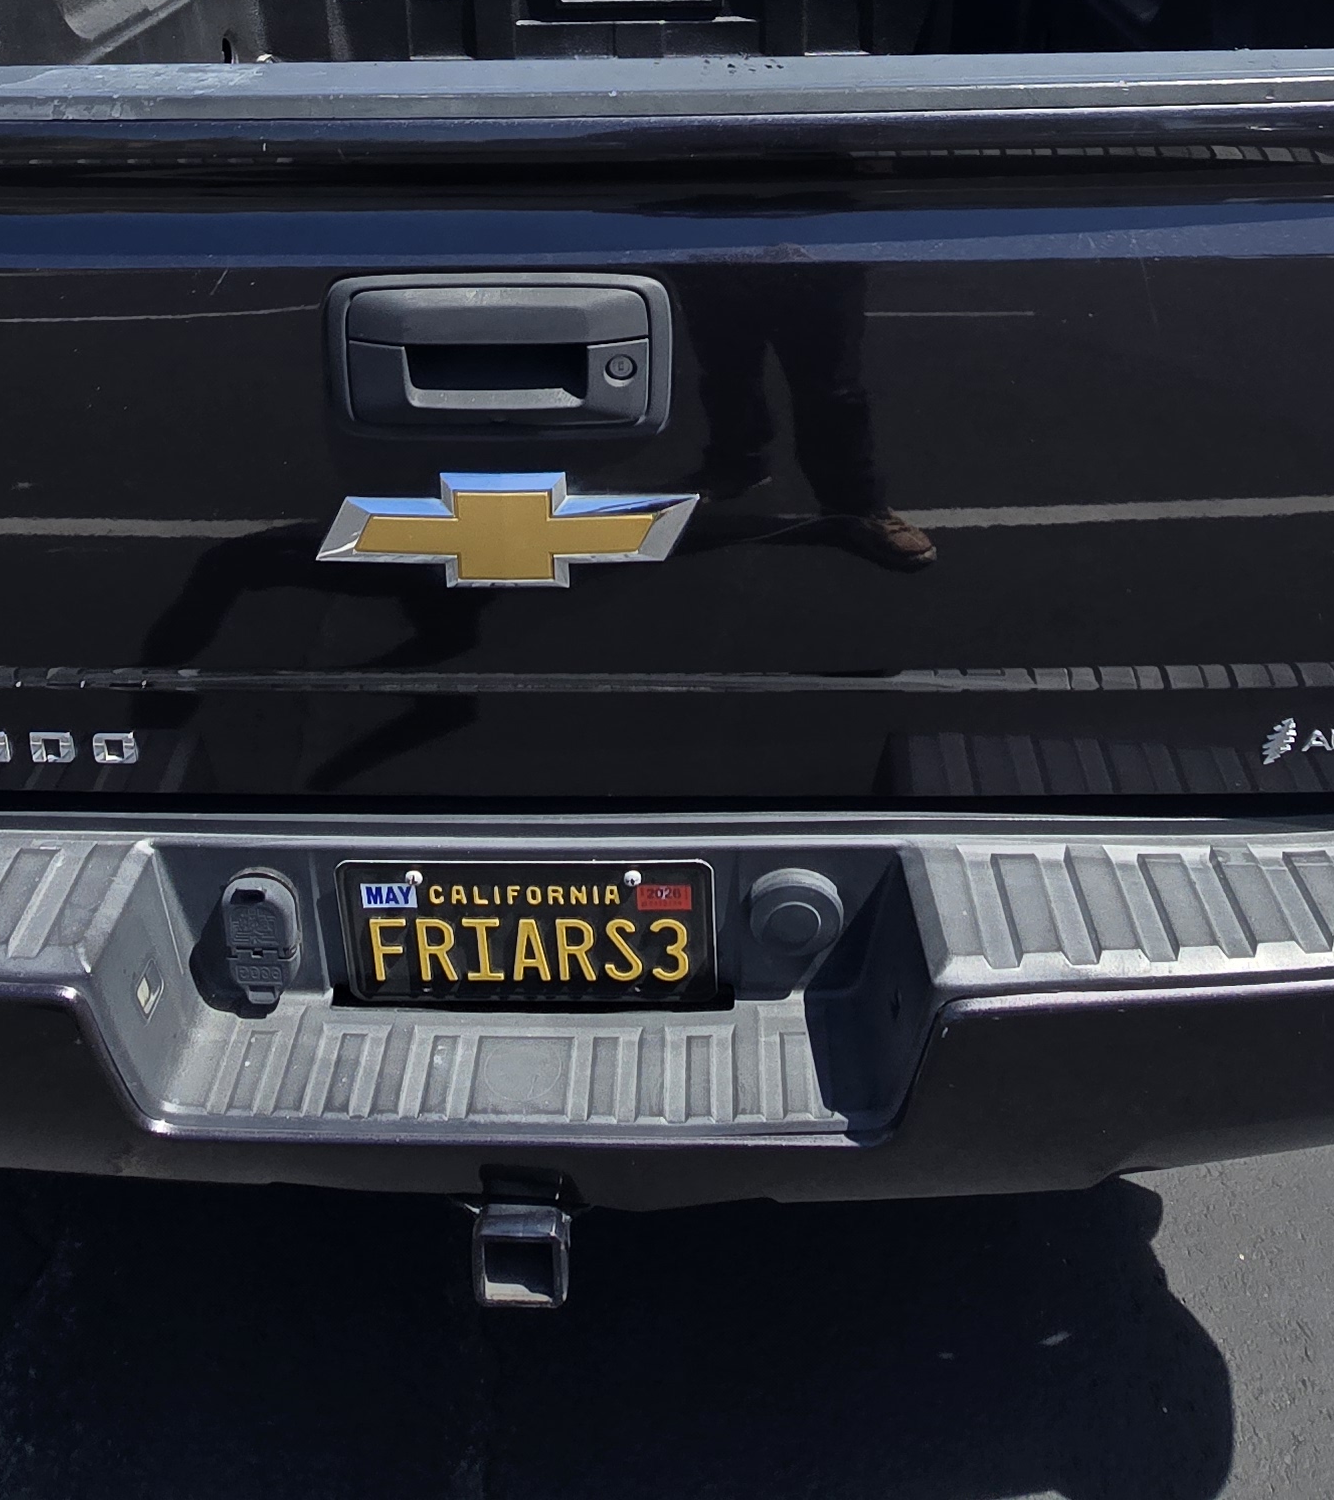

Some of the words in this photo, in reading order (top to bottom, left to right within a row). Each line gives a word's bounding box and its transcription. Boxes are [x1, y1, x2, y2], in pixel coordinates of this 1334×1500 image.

[365, 885, 413, 906] MAY
[428, 884, 622, 906] CALIFORNIA
[369, 916, 690, 982] FRIARS3
